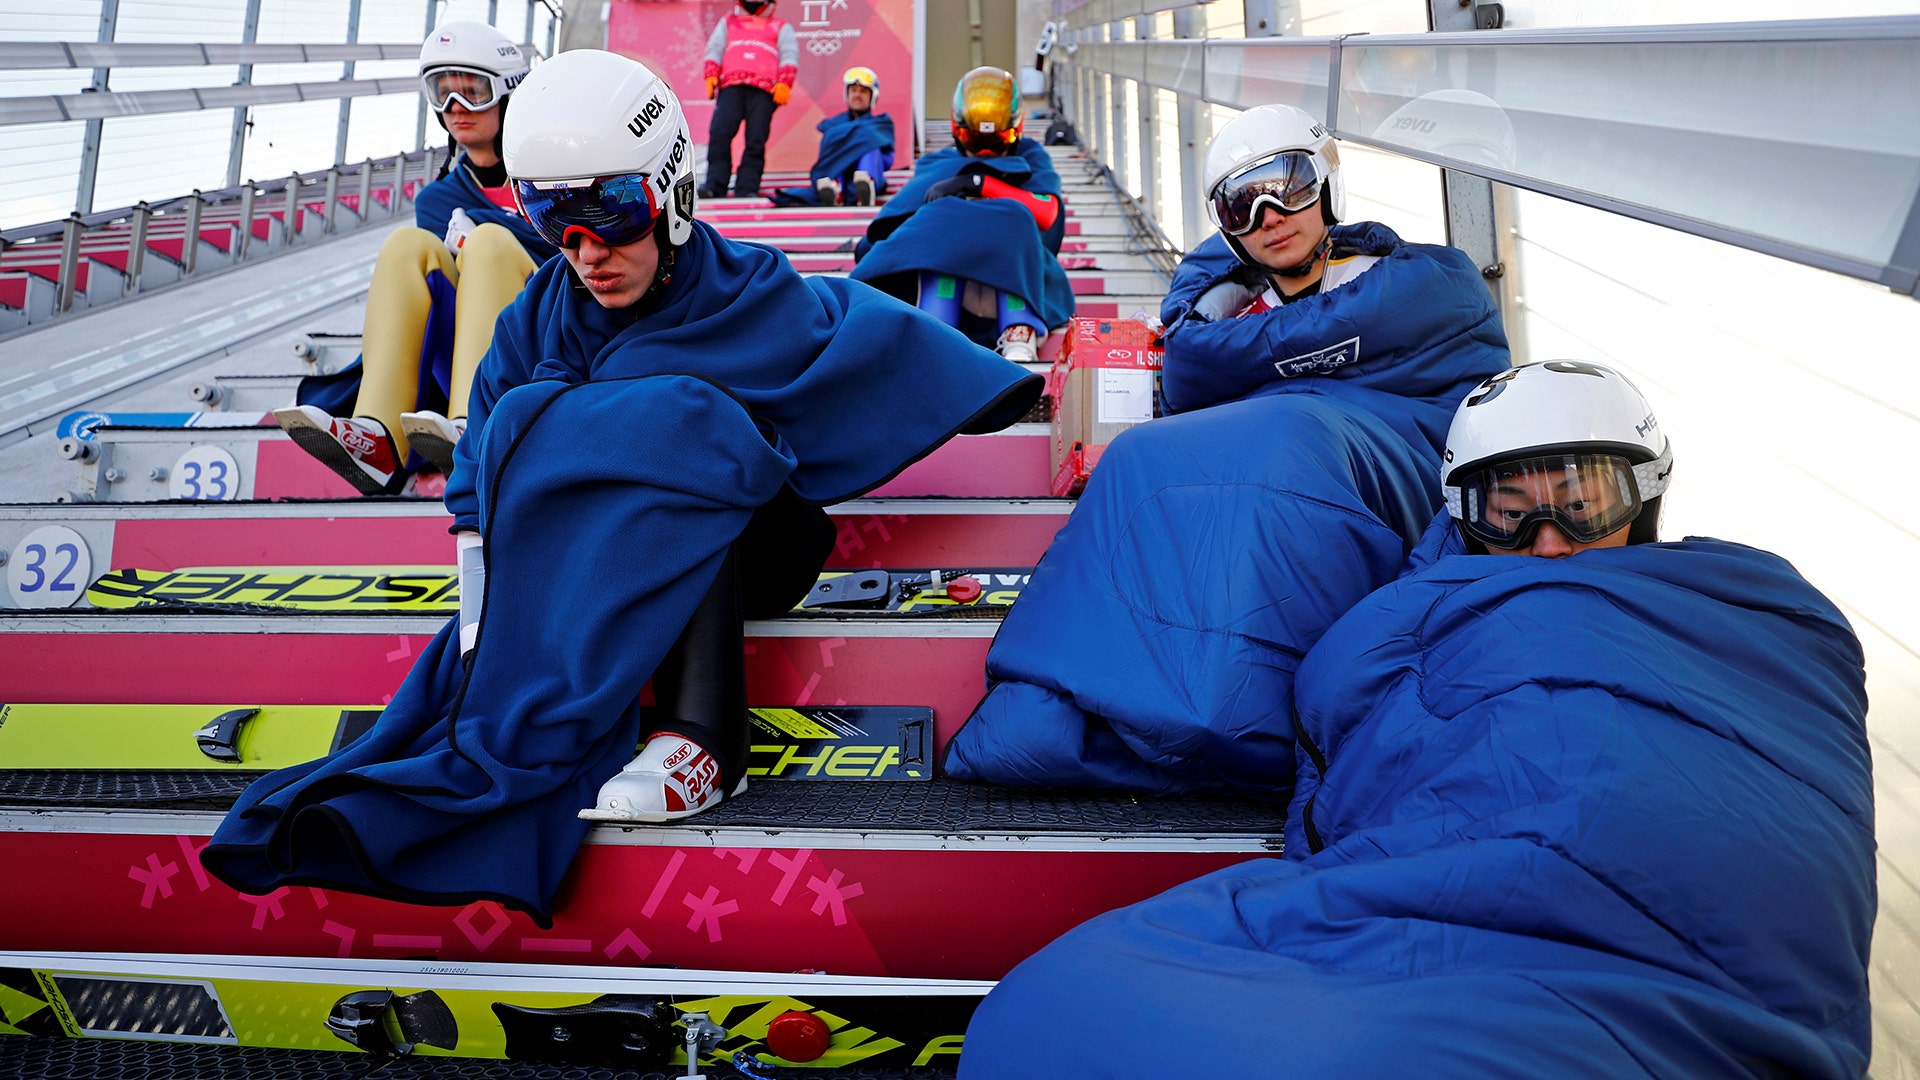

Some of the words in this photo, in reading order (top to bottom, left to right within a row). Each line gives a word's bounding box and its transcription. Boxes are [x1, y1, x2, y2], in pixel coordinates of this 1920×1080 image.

[627, 94, 666, 138] uvex
[655, 128, 687, 194] uvex
[345, 431, 375, 451] RAST
[1635, 412, 1658, 439] HE
[183, 460, 228, 499] 33
[18, 542, 77, 593] 32
[666, 745, 688, 767] RAST
[687, 756, 716, 799] RAST
[37, 971, 78, 1036] FISCHER
